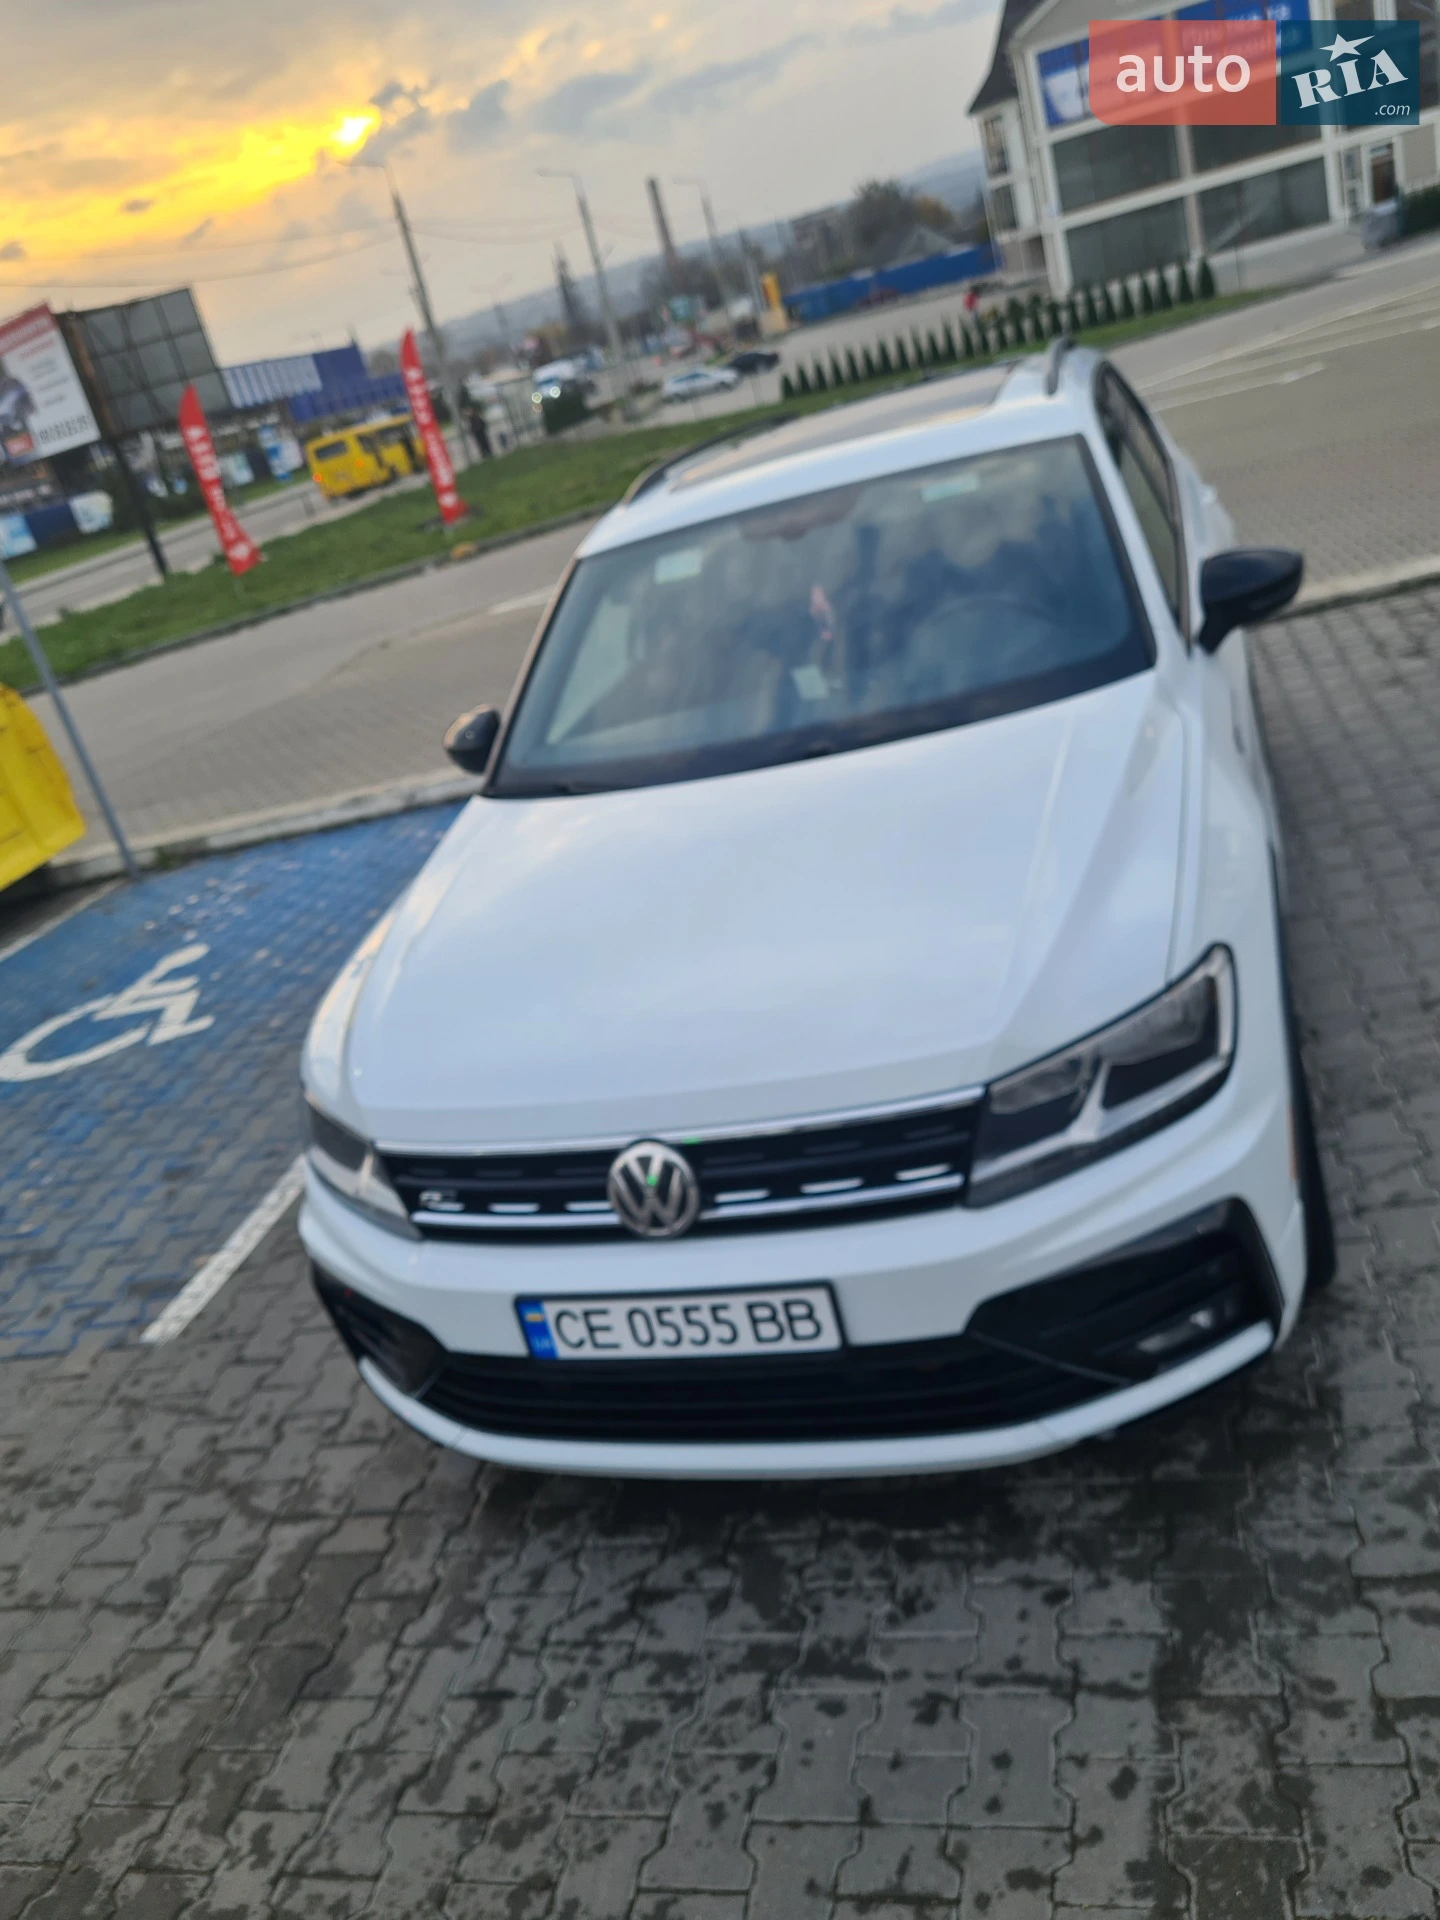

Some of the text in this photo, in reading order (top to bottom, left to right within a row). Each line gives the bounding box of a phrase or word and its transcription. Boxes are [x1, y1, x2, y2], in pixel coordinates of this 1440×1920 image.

[555, 1299, 822, 1349] CE 0555 BB
